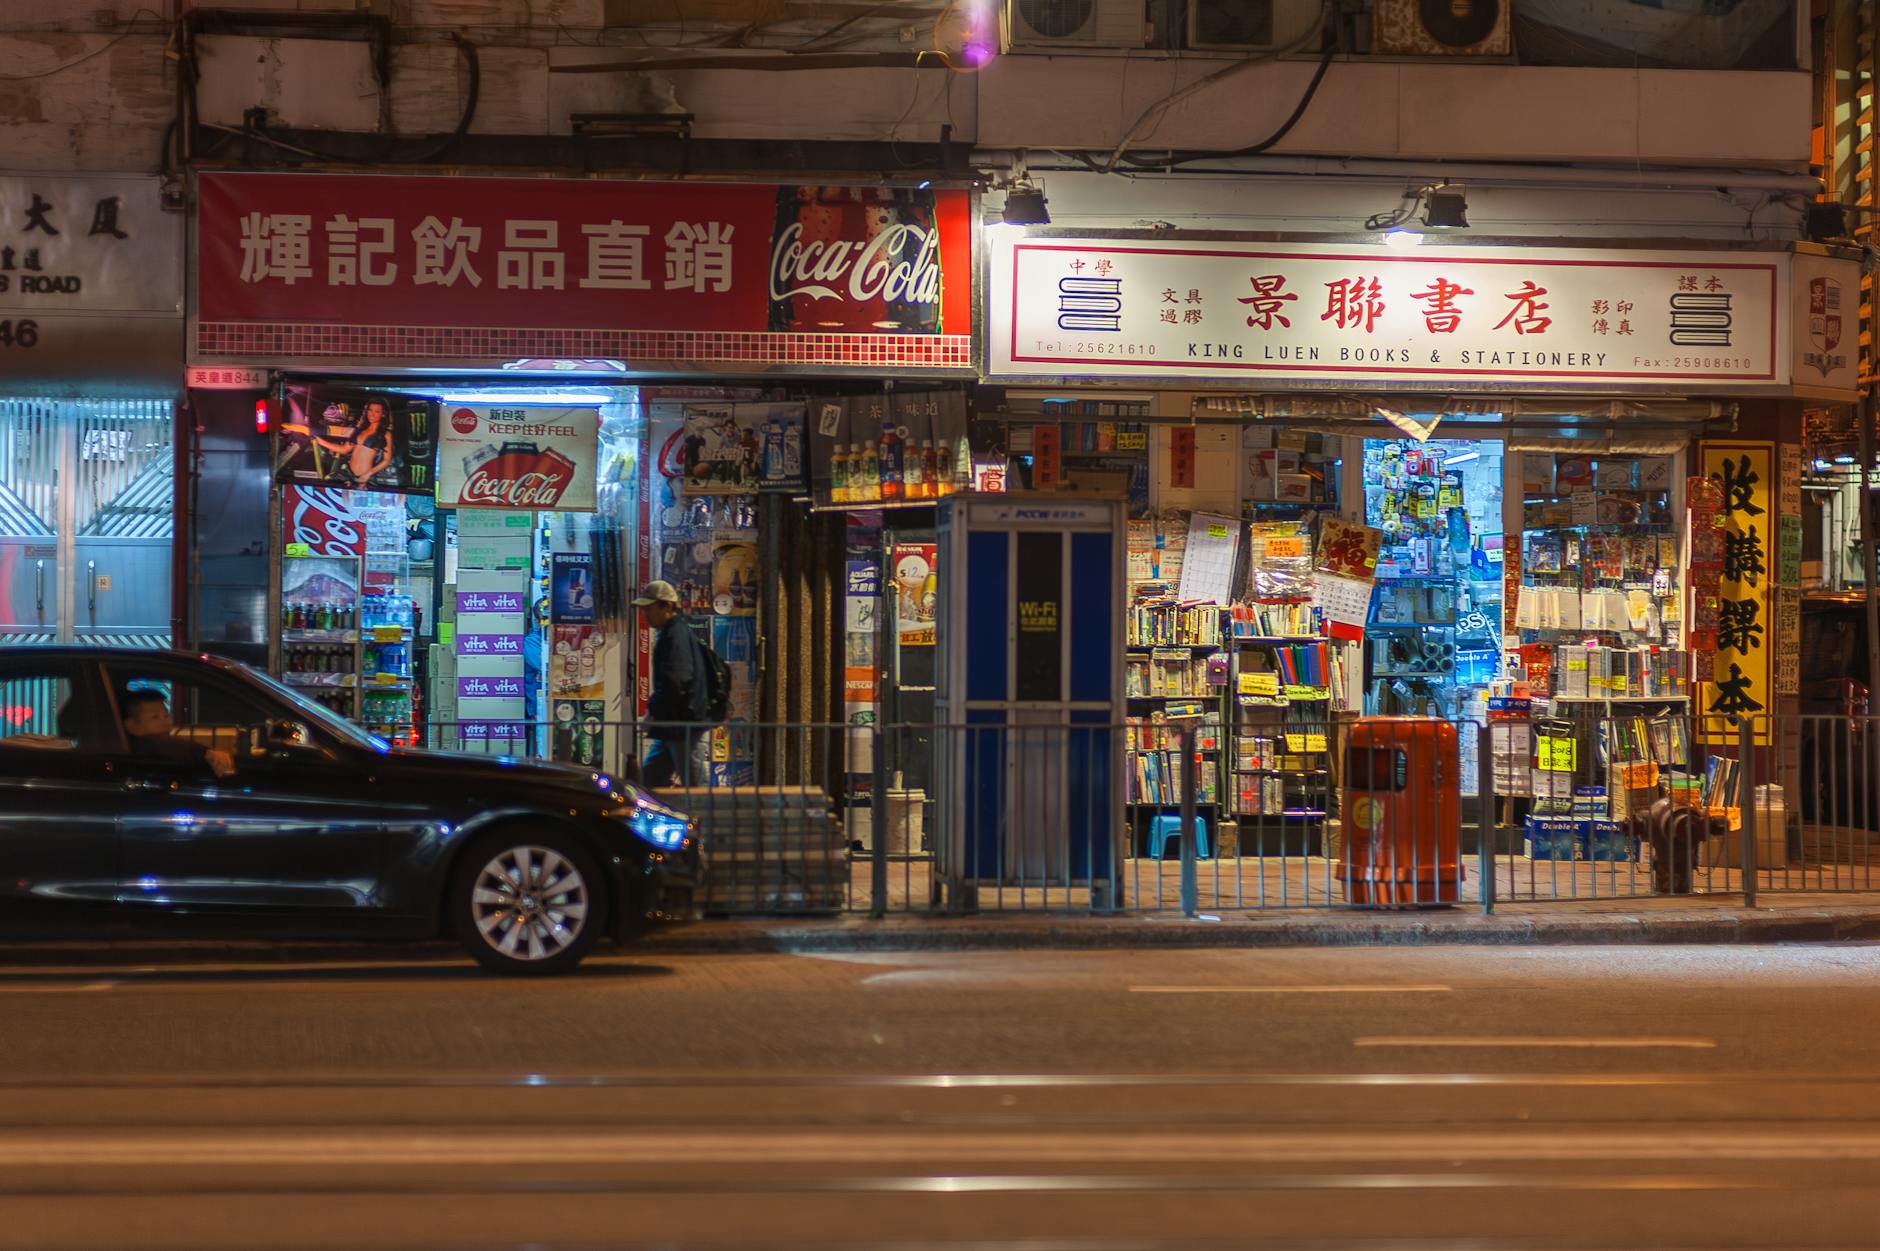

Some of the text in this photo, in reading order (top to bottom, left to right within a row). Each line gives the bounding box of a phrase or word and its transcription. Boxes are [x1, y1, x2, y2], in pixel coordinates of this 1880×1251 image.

[239, 212, 735, 293] 輝記飲品直銷
[770, 221, 941, 305] Coca-Cola
[1069, 257, 1113, 277] 中學
[20, 275, 81, 293] ROAD
[1677, 275, 1724, 292] 課本
[1160, 287, 1203, 304] 文具
[1237, 274, 1552, 335] 景聯書店
[1592, 299, 1634, 315] 影印
[1160, 308, 1203, 325] 過膠
[1592, 318, 1635, 336] 傳真
[1188, 343, 1607, 367] KING LUEN BOOKS & STATIONERY
[489, 408, 526, 422] 新包裝
[461, 471, 564, 506] Coca-Cola
[463, 594, 518, 608] vita vita
[1019, 602, 1057, 616] Wi-Fi
[464, 636, 518, 650] vita vita
[464, 679, 519, 693] vita vita
